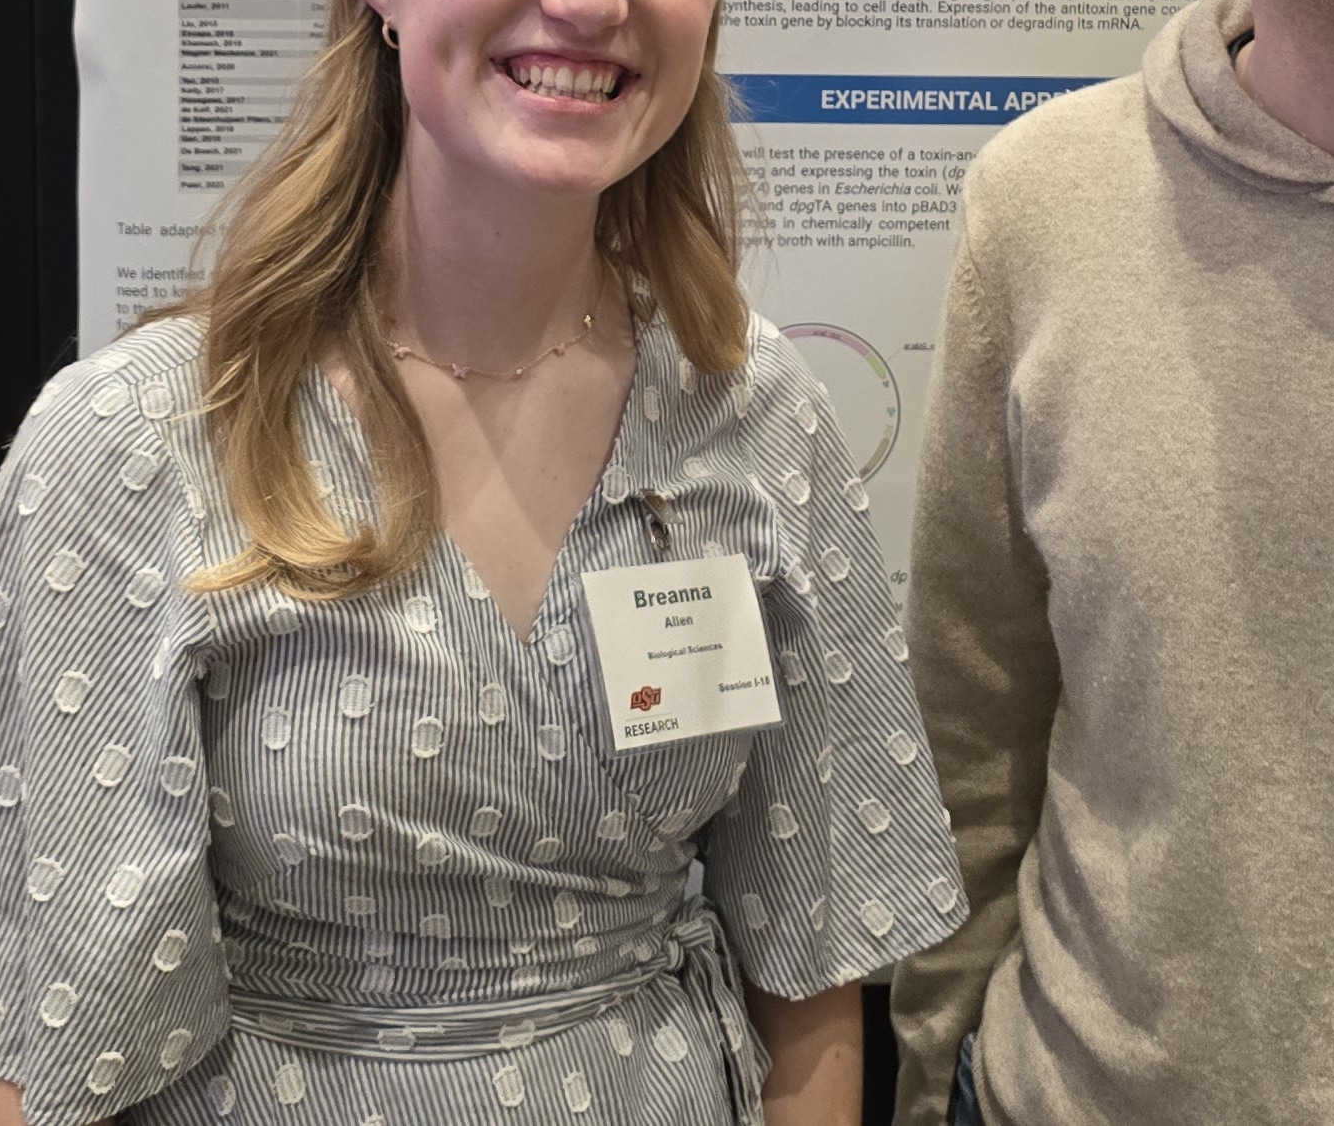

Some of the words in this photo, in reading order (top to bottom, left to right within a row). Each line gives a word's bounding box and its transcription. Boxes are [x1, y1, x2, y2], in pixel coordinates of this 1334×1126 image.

[821, 89, 999, 111] EXPERIMENTAL
[768, 148, 795, 161] test
[797, 146, 820, 161] the
[823, 149, 885, 163] presence
[888, 146, 904, 161] of
[906, 149, 916, 161] a
[773, 183, 815, 197] genes
[818, 181, 831, 195] in
[834, 181, 913, 196] Escherichia
[914, 183, 942, 197] coli.
[633, 585, 713, 609] Breanna
[664, 615, 694, 629] Allen
[630, 685, 662, 712] OSU
[624, 717, 679, 738] RESEARCH
